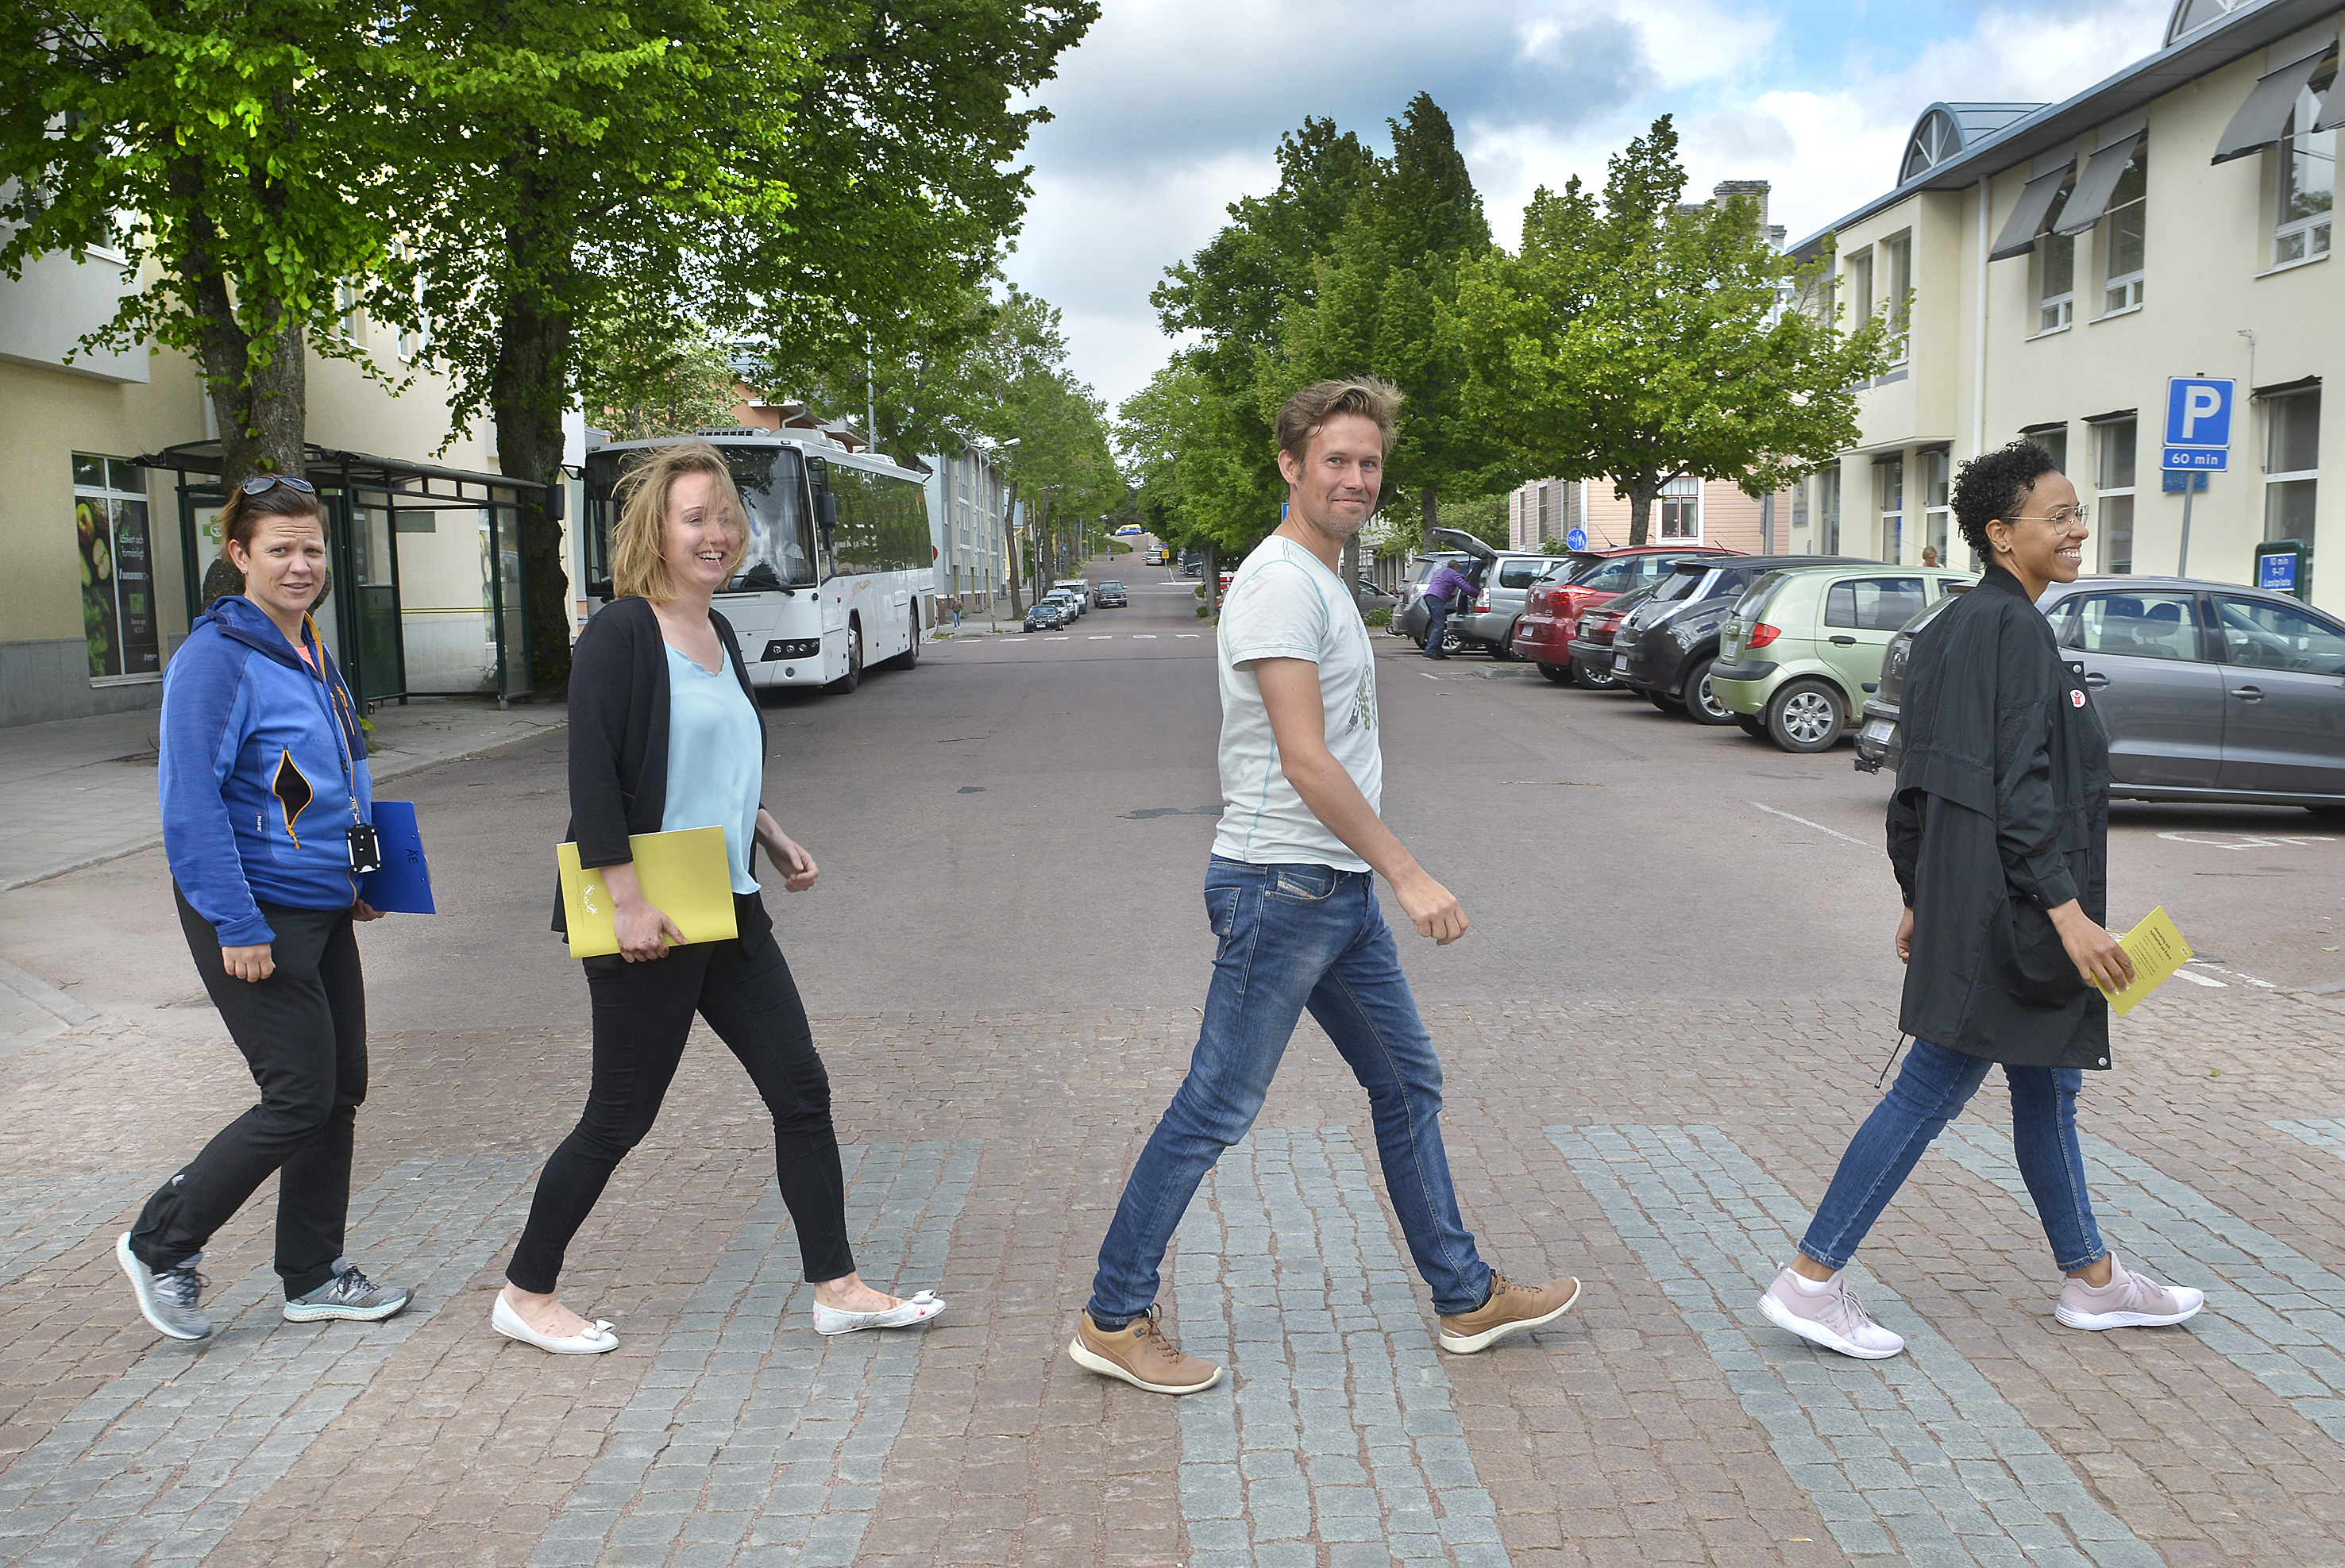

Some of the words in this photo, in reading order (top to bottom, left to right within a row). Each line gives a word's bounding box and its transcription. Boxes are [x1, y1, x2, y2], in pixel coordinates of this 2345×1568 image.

[2182, 386, 2222, 438] P
[2172, 453, 2190, 464] 60
[2194, 454, 2218, 464] min
[2272, 567, 2285, 576] 9-17
[2264, 578, 2291, 588] Lastplats
[405, 848, 419, 865] ÅE
